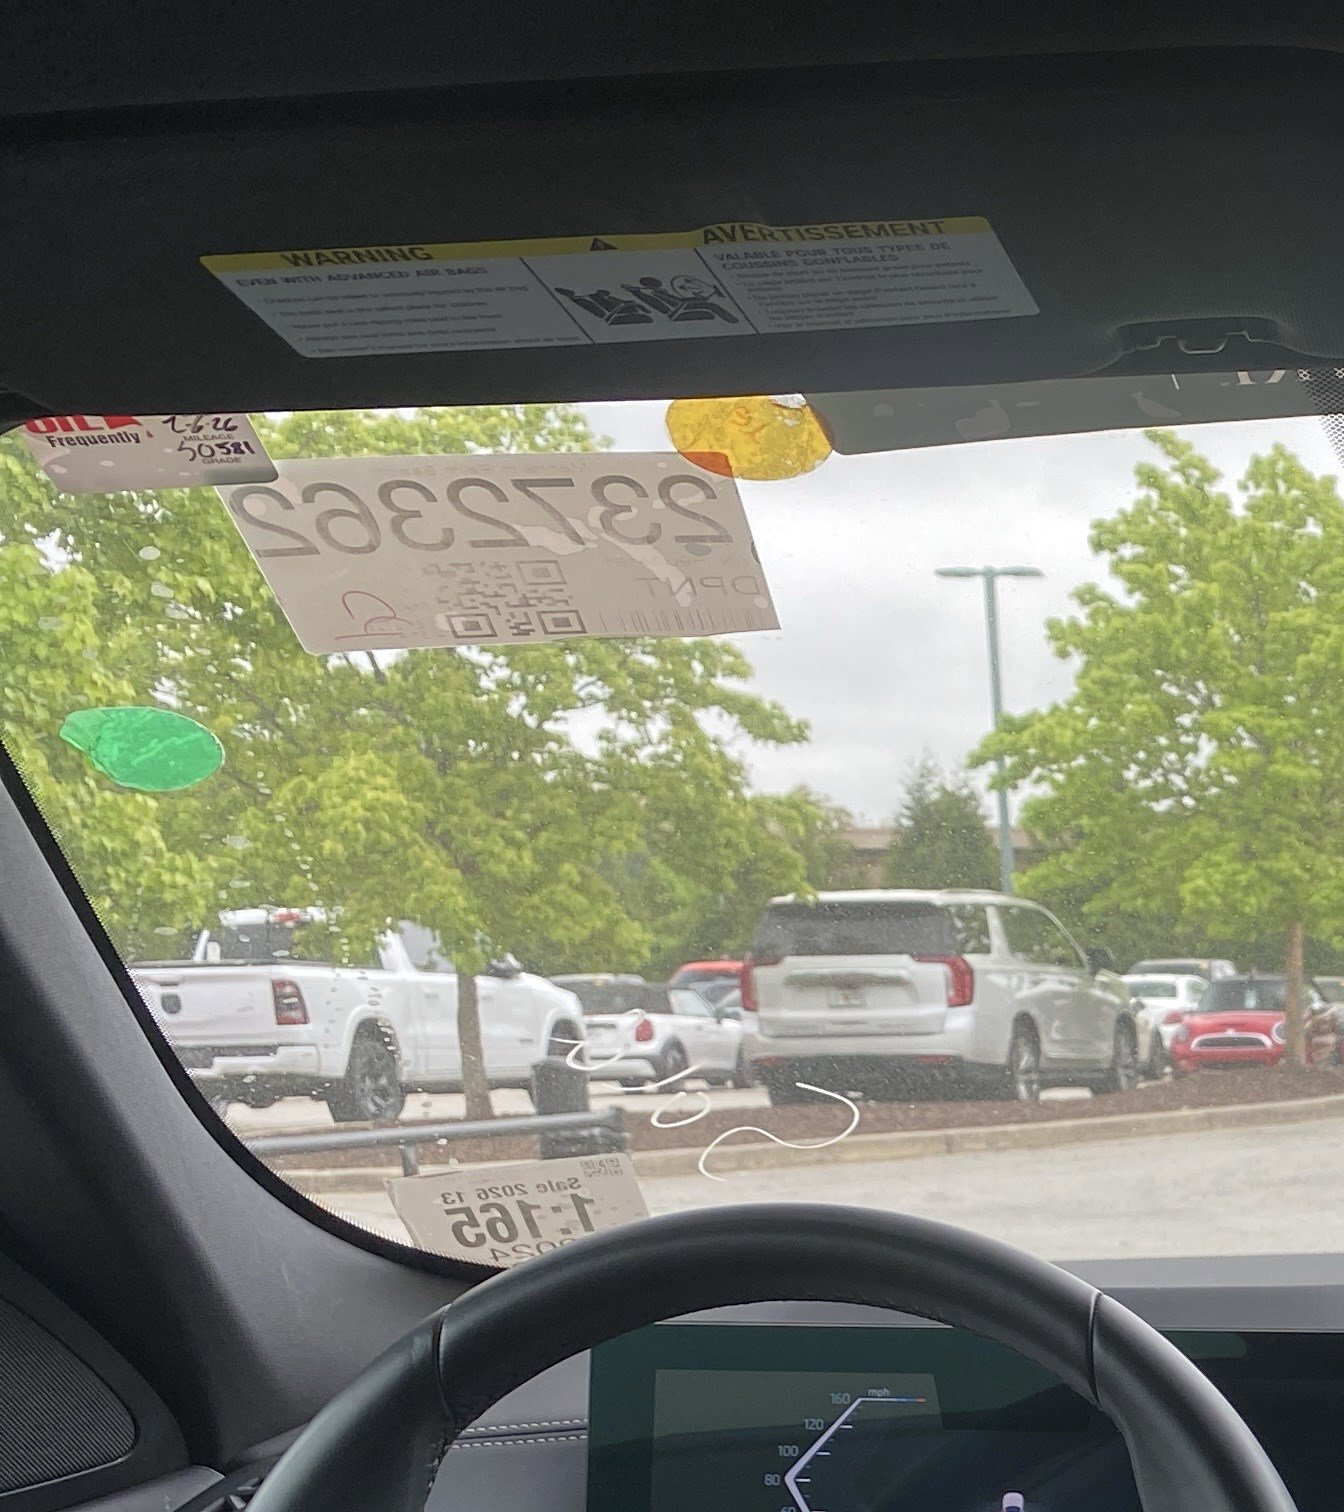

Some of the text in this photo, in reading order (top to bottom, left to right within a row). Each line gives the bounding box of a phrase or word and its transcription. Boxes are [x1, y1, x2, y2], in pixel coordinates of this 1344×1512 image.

[703, 221, 945, 245] AVERTISSEMENT
[281, 246, 434, 267] WARNING
[714, 250, 780, 262] VALABLE
[834, 245, 873, 255] TOUS
[930, 241, 949, 250] DE
[281, 274, 322, 285] WITH
[326, 270, 410, 283] ADVANCED
[415, 268, 440, 278] AIR
[46, 429, 141, 448] Frequently
[201, 456, 241, 464] GRADE
[829, 1392, 850, 1405] 160
[868, 1387, 890, 1398] mph
[803, 1418, 824, 1430] 120
[777, 1445, 798, 1457] 100
[764, 1474, 780, 1486] 80
